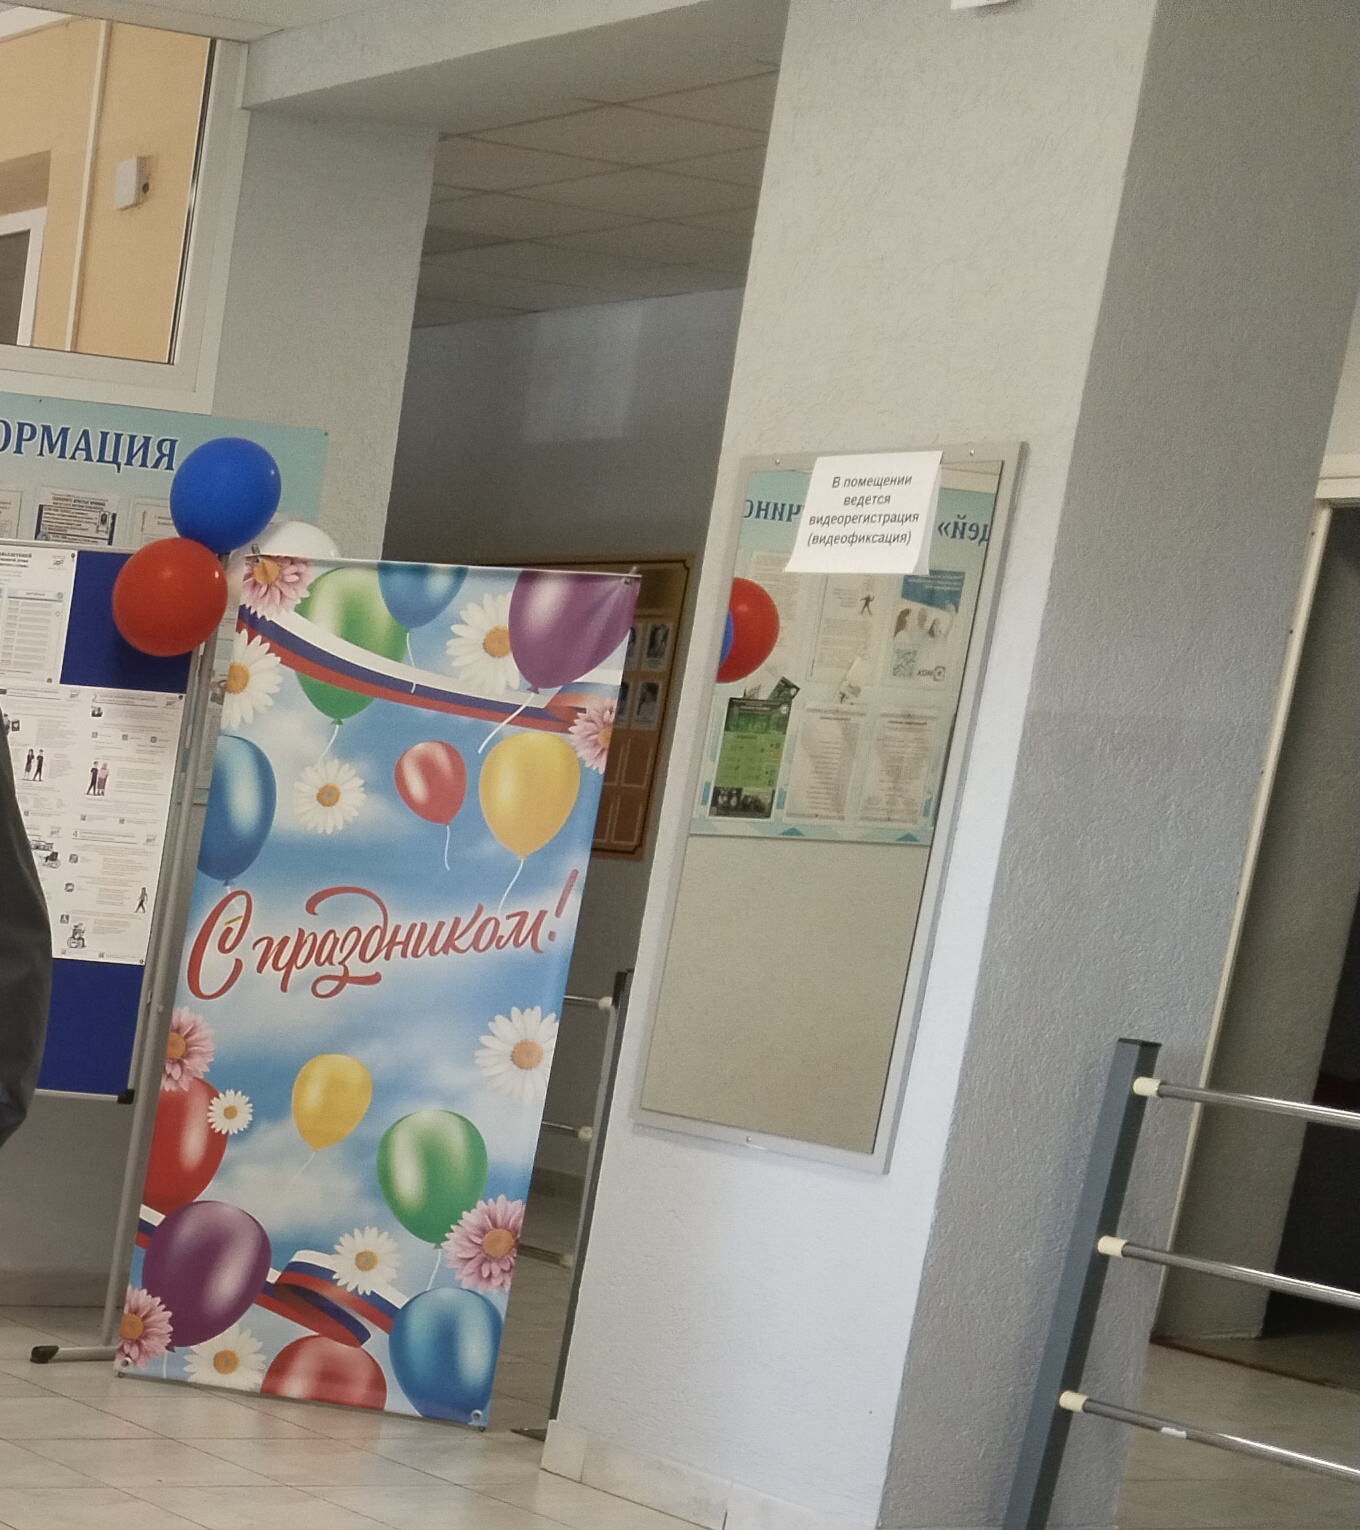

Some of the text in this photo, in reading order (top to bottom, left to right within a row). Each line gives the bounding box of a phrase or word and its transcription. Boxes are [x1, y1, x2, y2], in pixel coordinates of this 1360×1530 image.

[832, 475, 912, 489] В помещении
[843, 495, 891, 507] ведется
[809, 512, 919, 527] видеорегистрация
[807, 531, 911, 547] (видеофиксация)
[187, 868, 579, 1000] С праздником!
